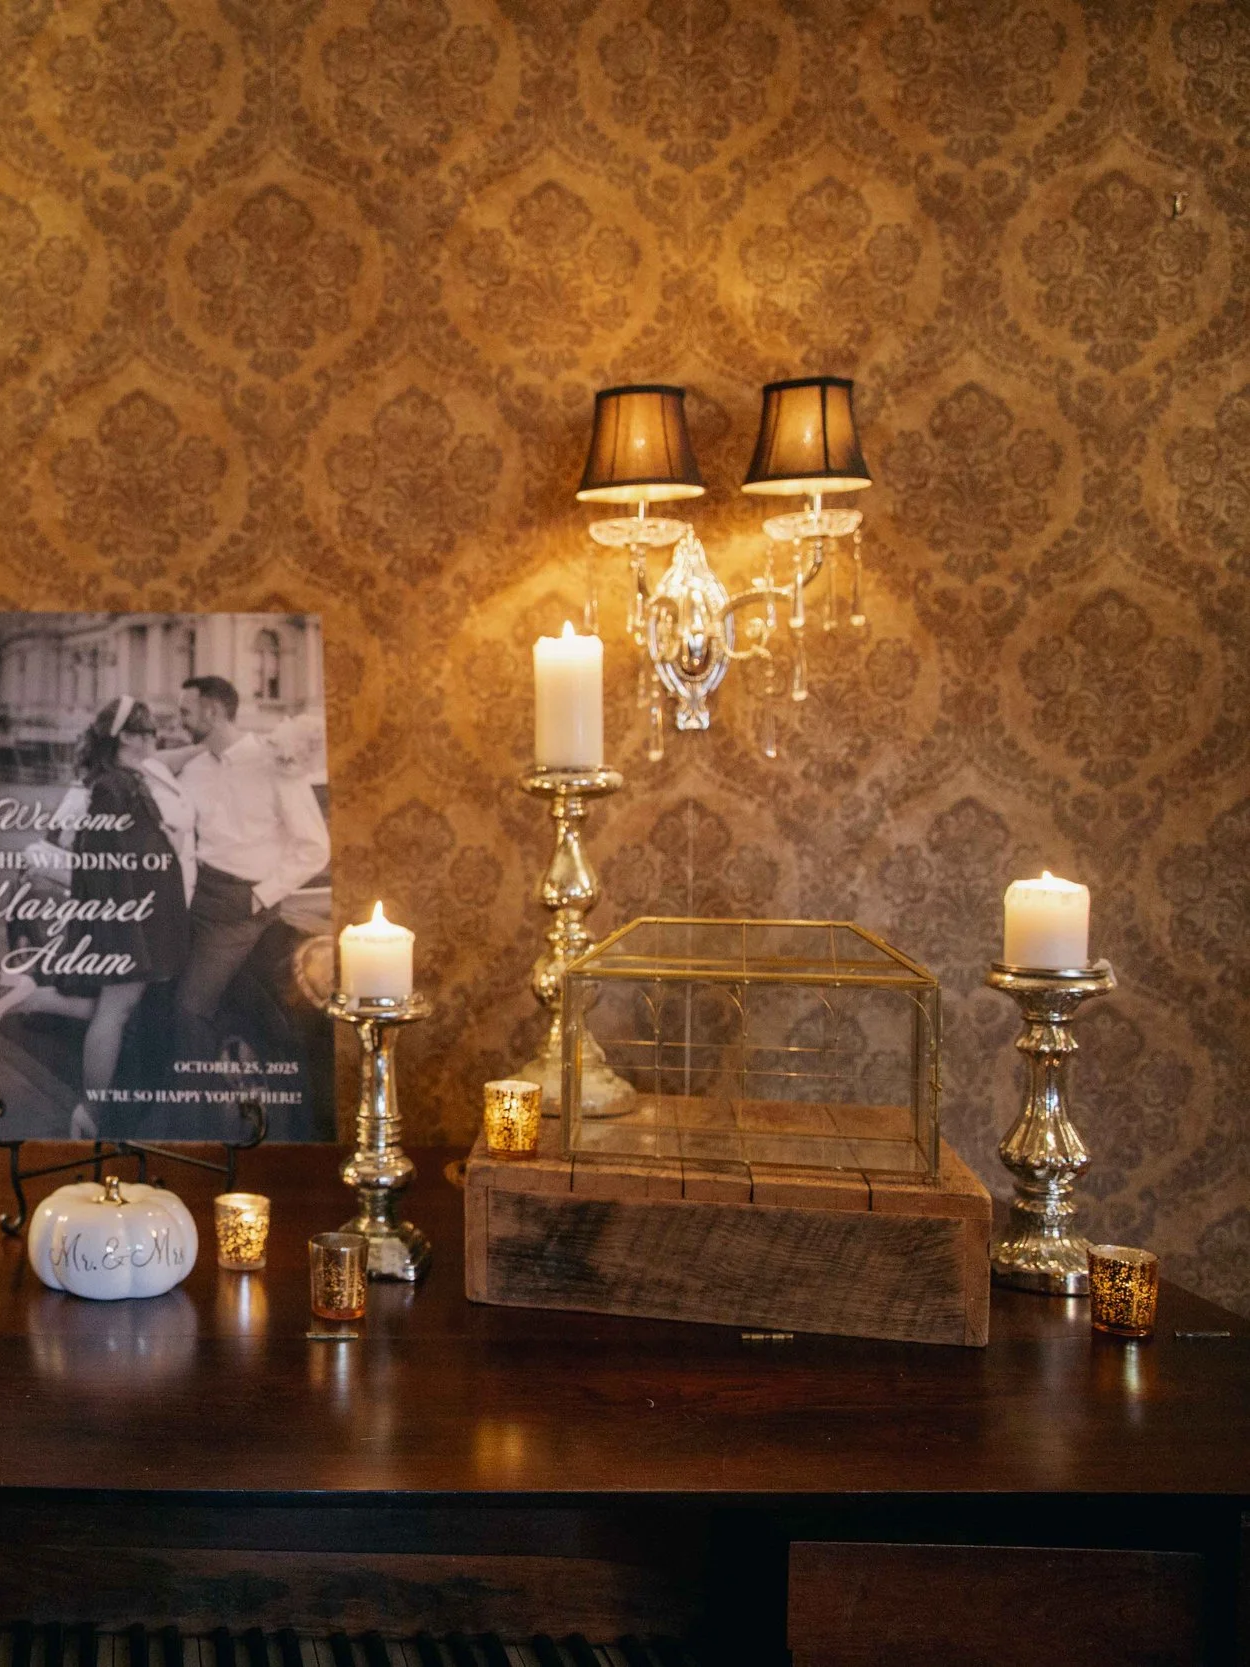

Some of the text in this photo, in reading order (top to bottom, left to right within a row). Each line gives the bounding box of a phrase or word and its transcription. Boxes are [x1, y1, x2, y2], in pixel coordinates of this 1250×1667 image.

[31, 851, 138, 872] WEDDING
[141, 852, 174, 872] OF
[0, 934, 137, 976] Adam
[173, 1060, 300, 1075] OCTOBER 25, 2025
[85, 1088, 130, 1102] WE'RE
[132, 1089, 154, 1103] SO
[155, 1089, 202, 1105] HAPPY
[260, 1091, 303, 1105] HERE!
[49, 1233, 98, 1273] Mr.
